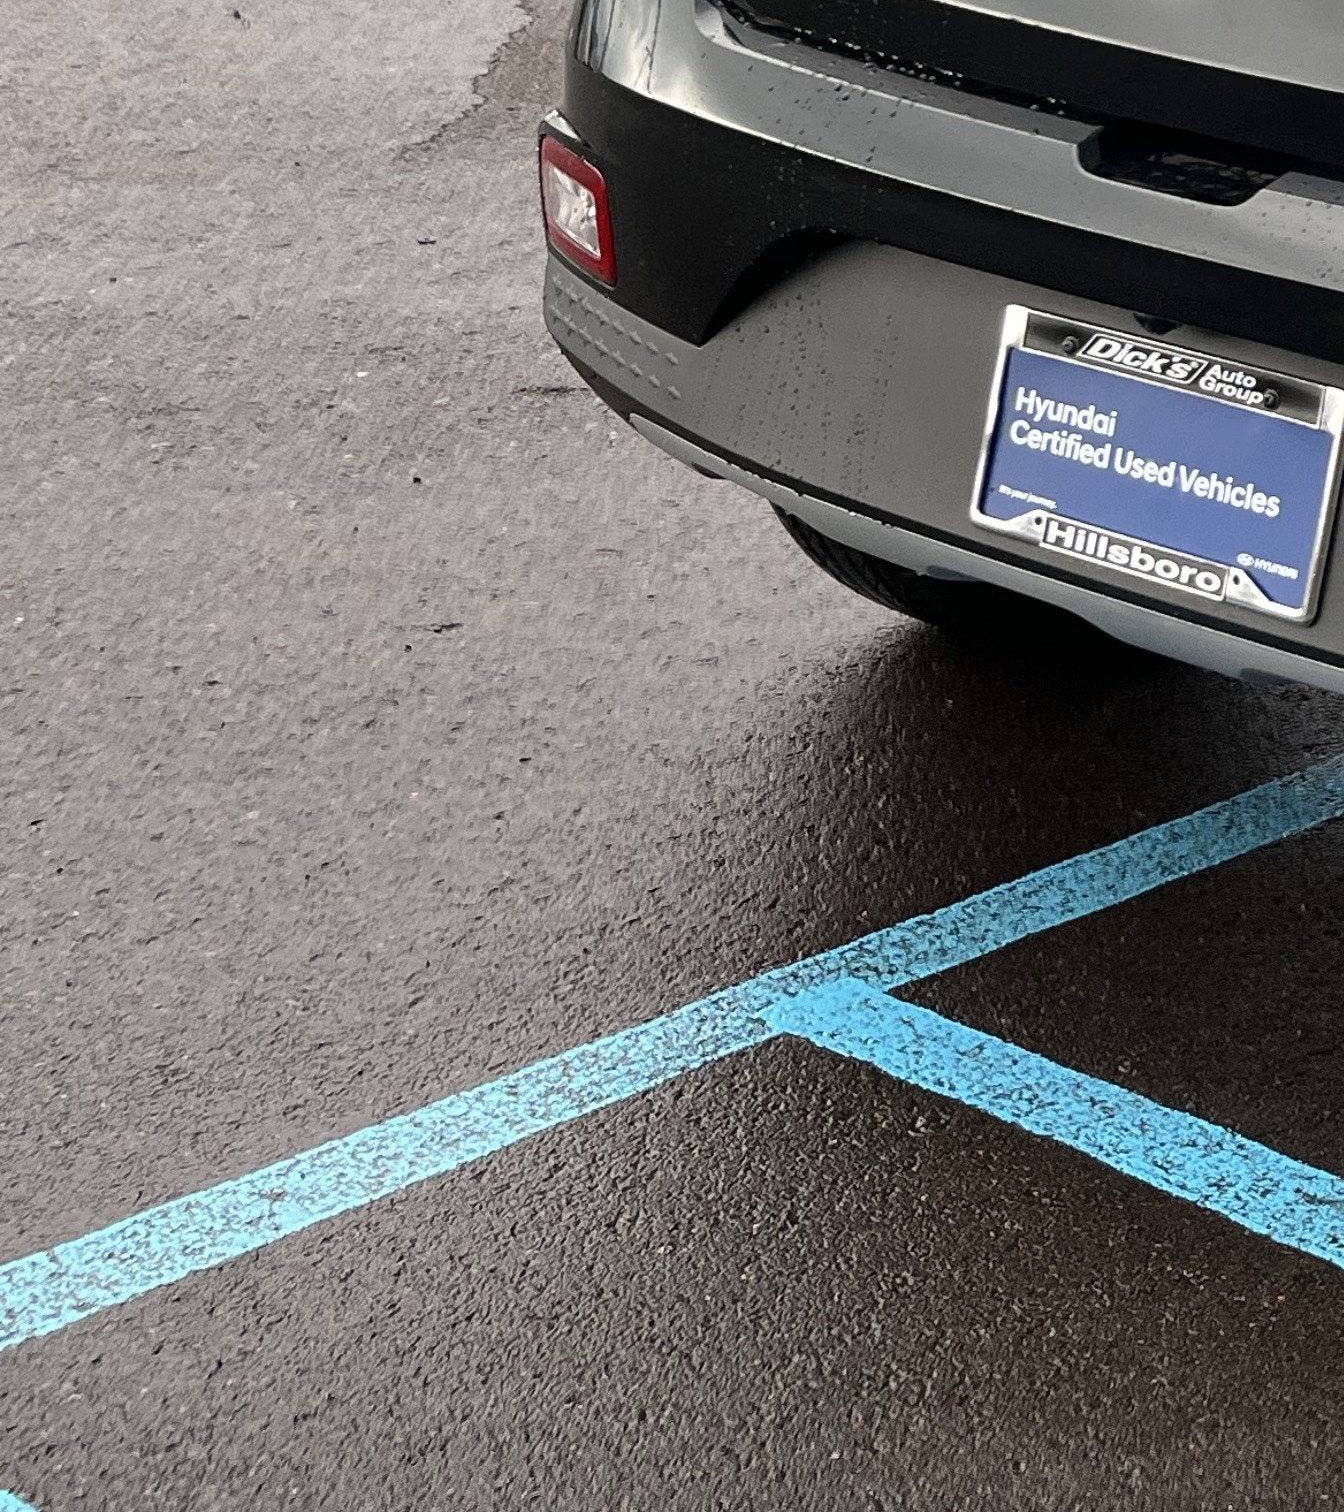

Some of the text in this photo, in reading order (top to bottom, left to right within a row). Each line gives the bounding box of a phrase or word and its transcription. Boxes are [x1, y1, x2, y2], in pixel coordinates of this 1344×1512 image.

[1088, 335, 1200, 381] Dick's
[1208, 363, 1257, 388] Auto
[1014, 386, 1118, 437] Hyundai
[1200, 375, 1263, 405] Group
[1010, 419, 1282, 518] Certified Used Vehicles
[1046, 519, 1222, 592] Hillsboro
